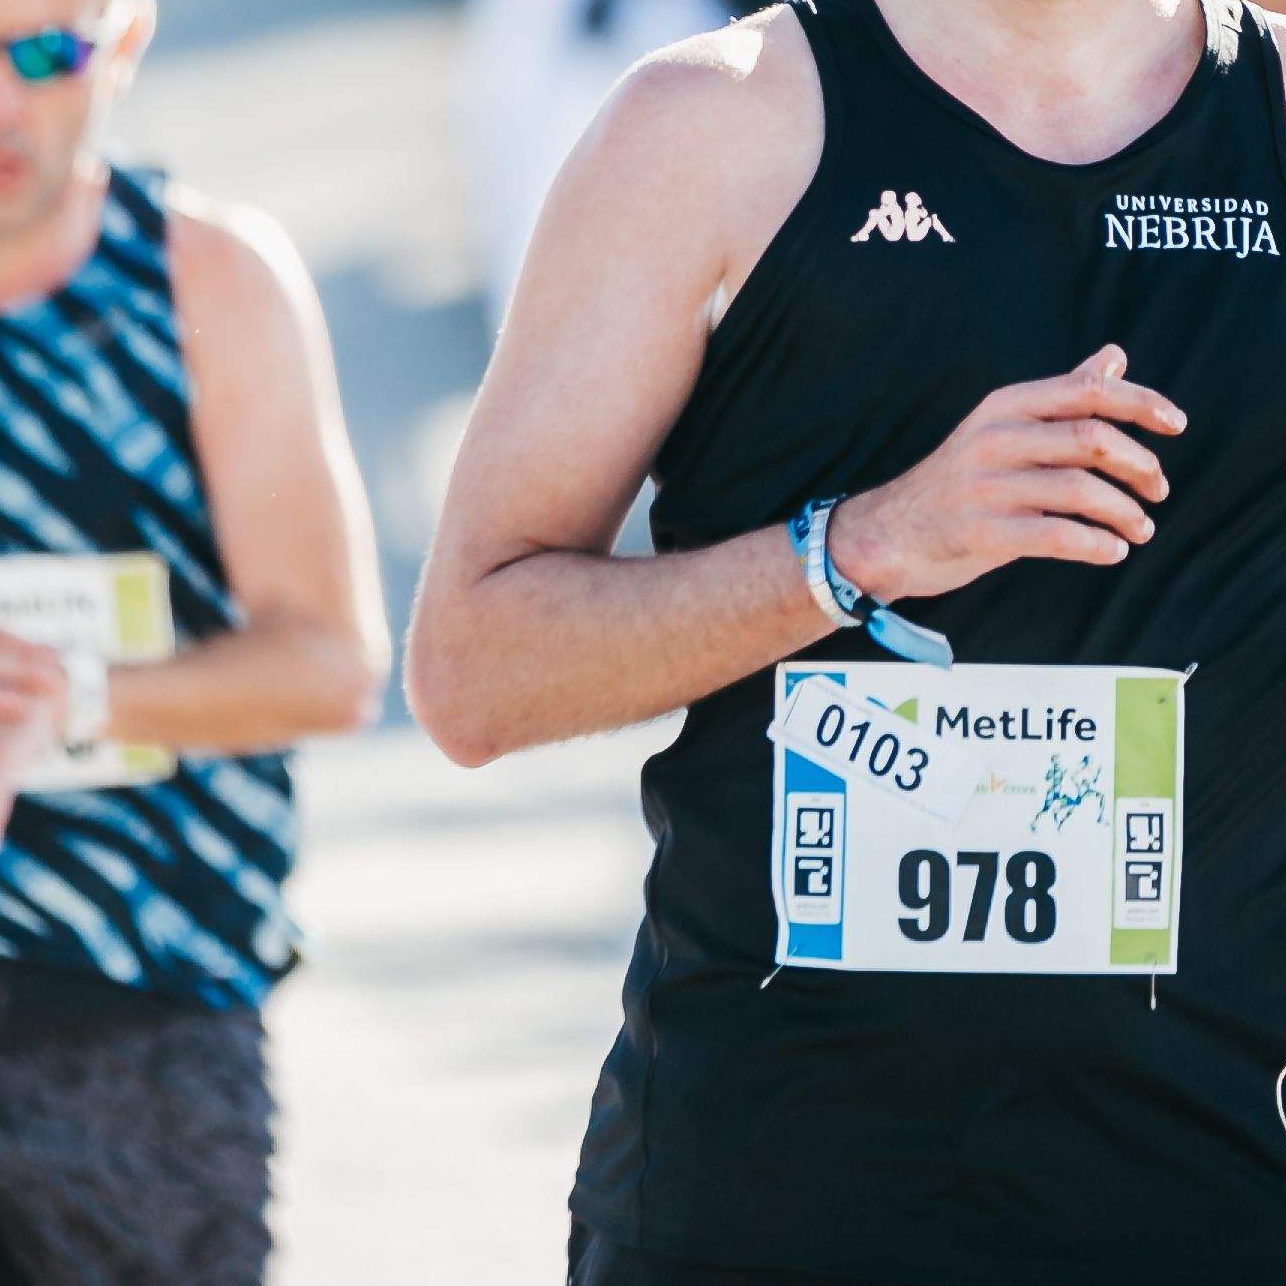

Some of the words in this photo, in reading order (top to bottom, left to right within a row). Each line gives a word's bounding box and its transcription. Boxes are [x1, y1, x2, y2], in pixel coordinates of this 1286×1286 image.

[1115, 194, 1269, 216] UNIVERSIDAD
[1104, 213, 1281, 259] NEBRIJA
[935, 706, 1098, 742] MetLife
[815, 703, 929, 793] 0103
[897, 848, 1057, 945] 978
